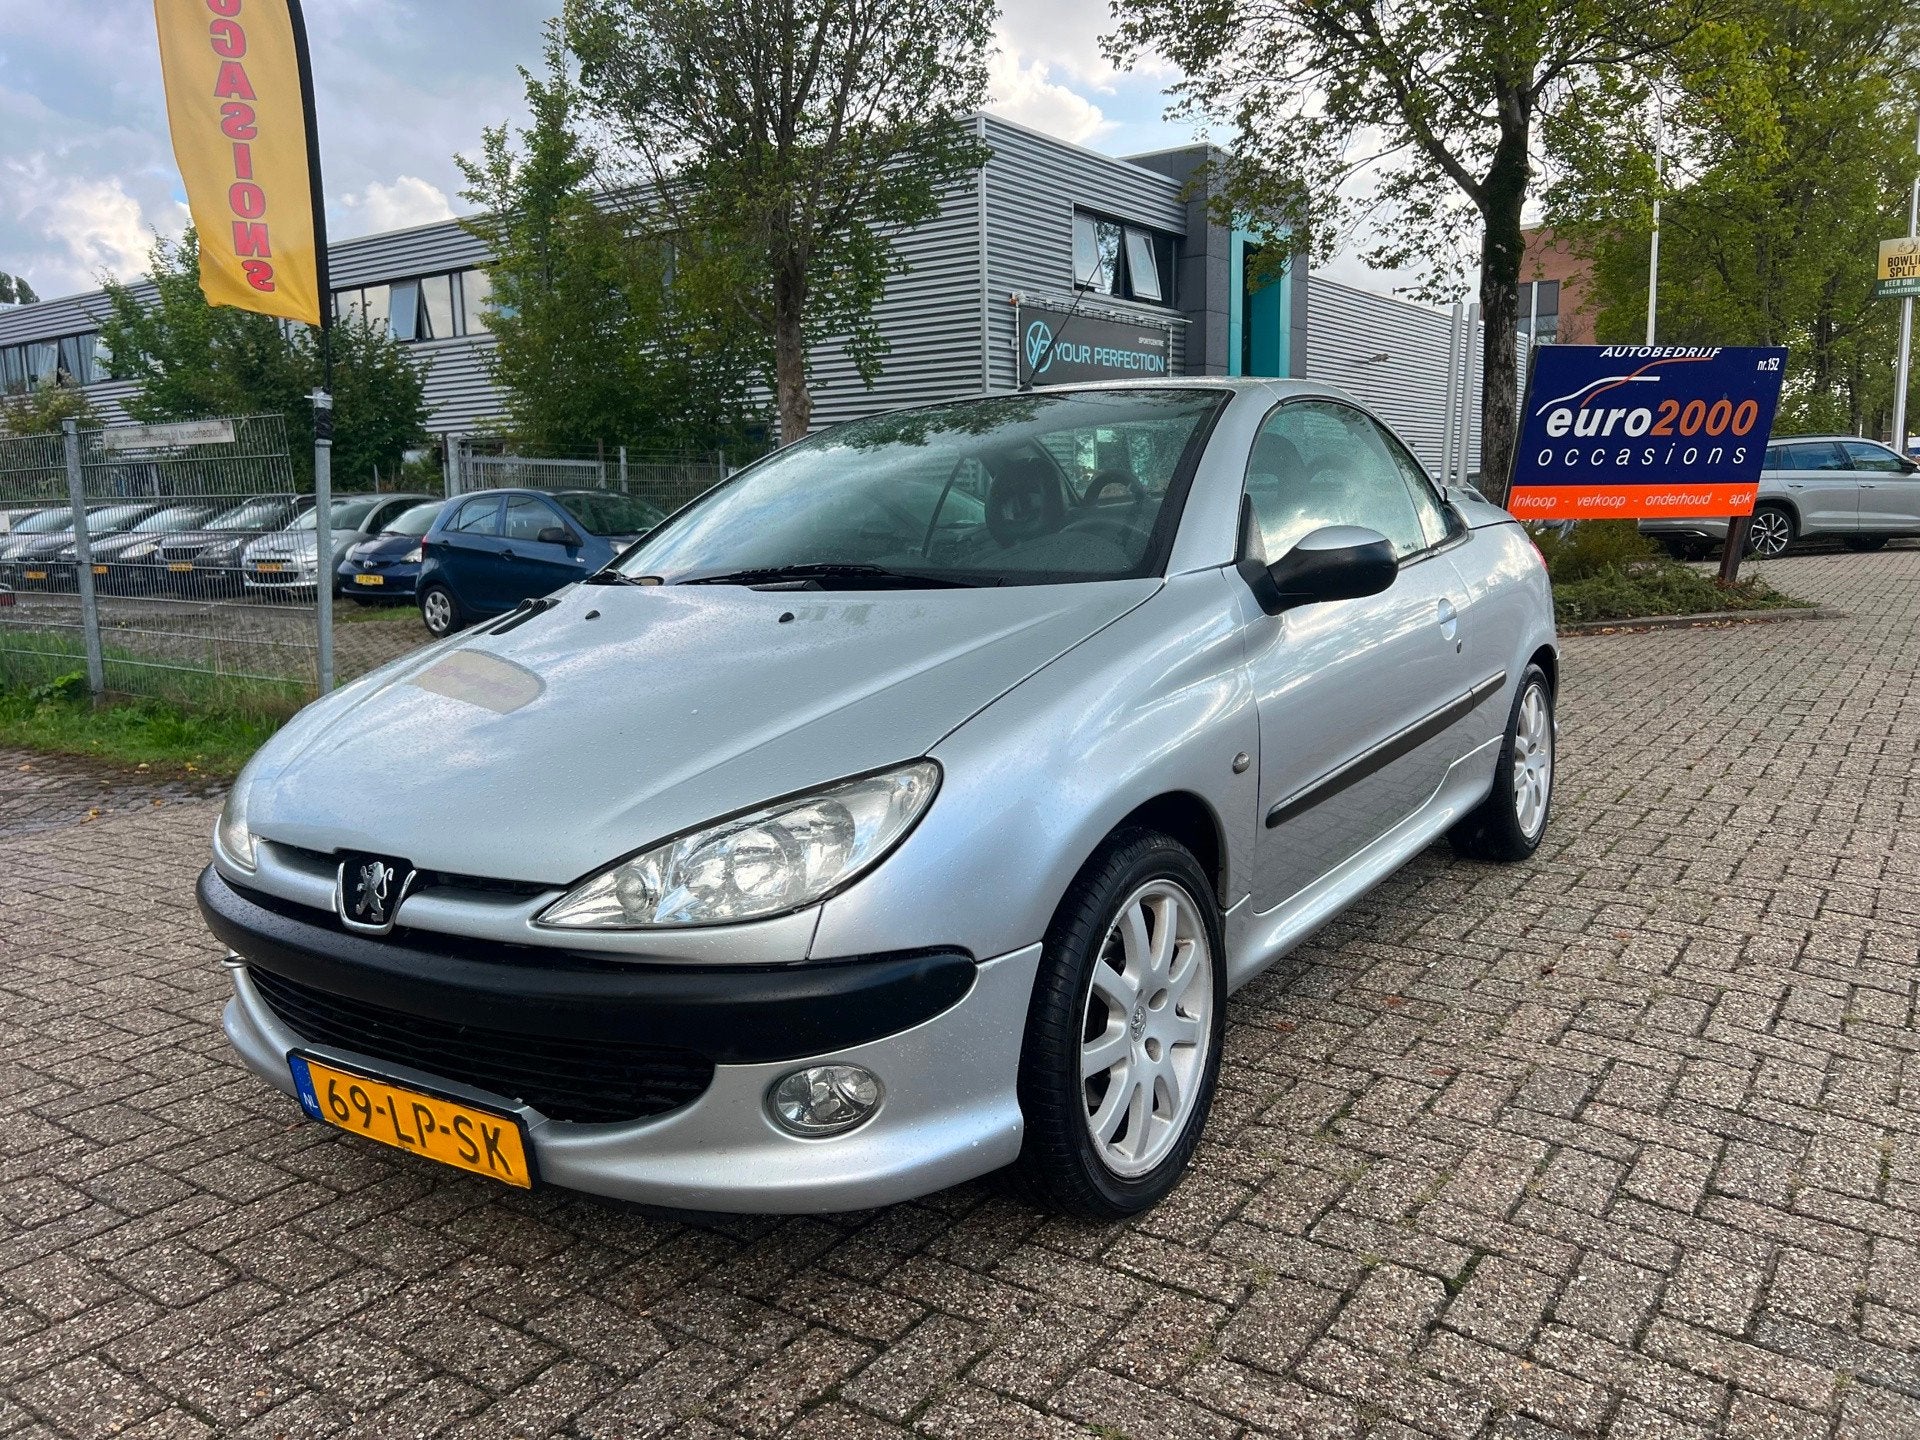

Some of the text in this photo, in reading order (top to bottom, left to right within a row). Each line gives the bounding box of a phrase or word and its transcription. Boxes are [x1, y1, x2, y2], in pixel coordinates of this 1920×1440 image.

[1888, 255, 1920, 267] BOWLI
[1890, 266, 1917, 277] SPLIT
[1055, 342, 1164, 372] YOUR PERFECTION
[1600, 346, 1722, 358] AUTOBEDRIJF
[1757, 357, 1780, 371] nr.152
[1546, 399, 1759, 437] euro2000
[1537, 443, 1747, 467] occasions
[1513, 495, 1557, 509] Inkoop
[1577, 494, 1626, 509] verkoop
[1645, 492, 1712, 506] onderhoud
[1729, 492, 1752, 507] apk
[302, 1092, 319, 1109] NL
[328, 1078, 514, 1176] 69-LP-SK
